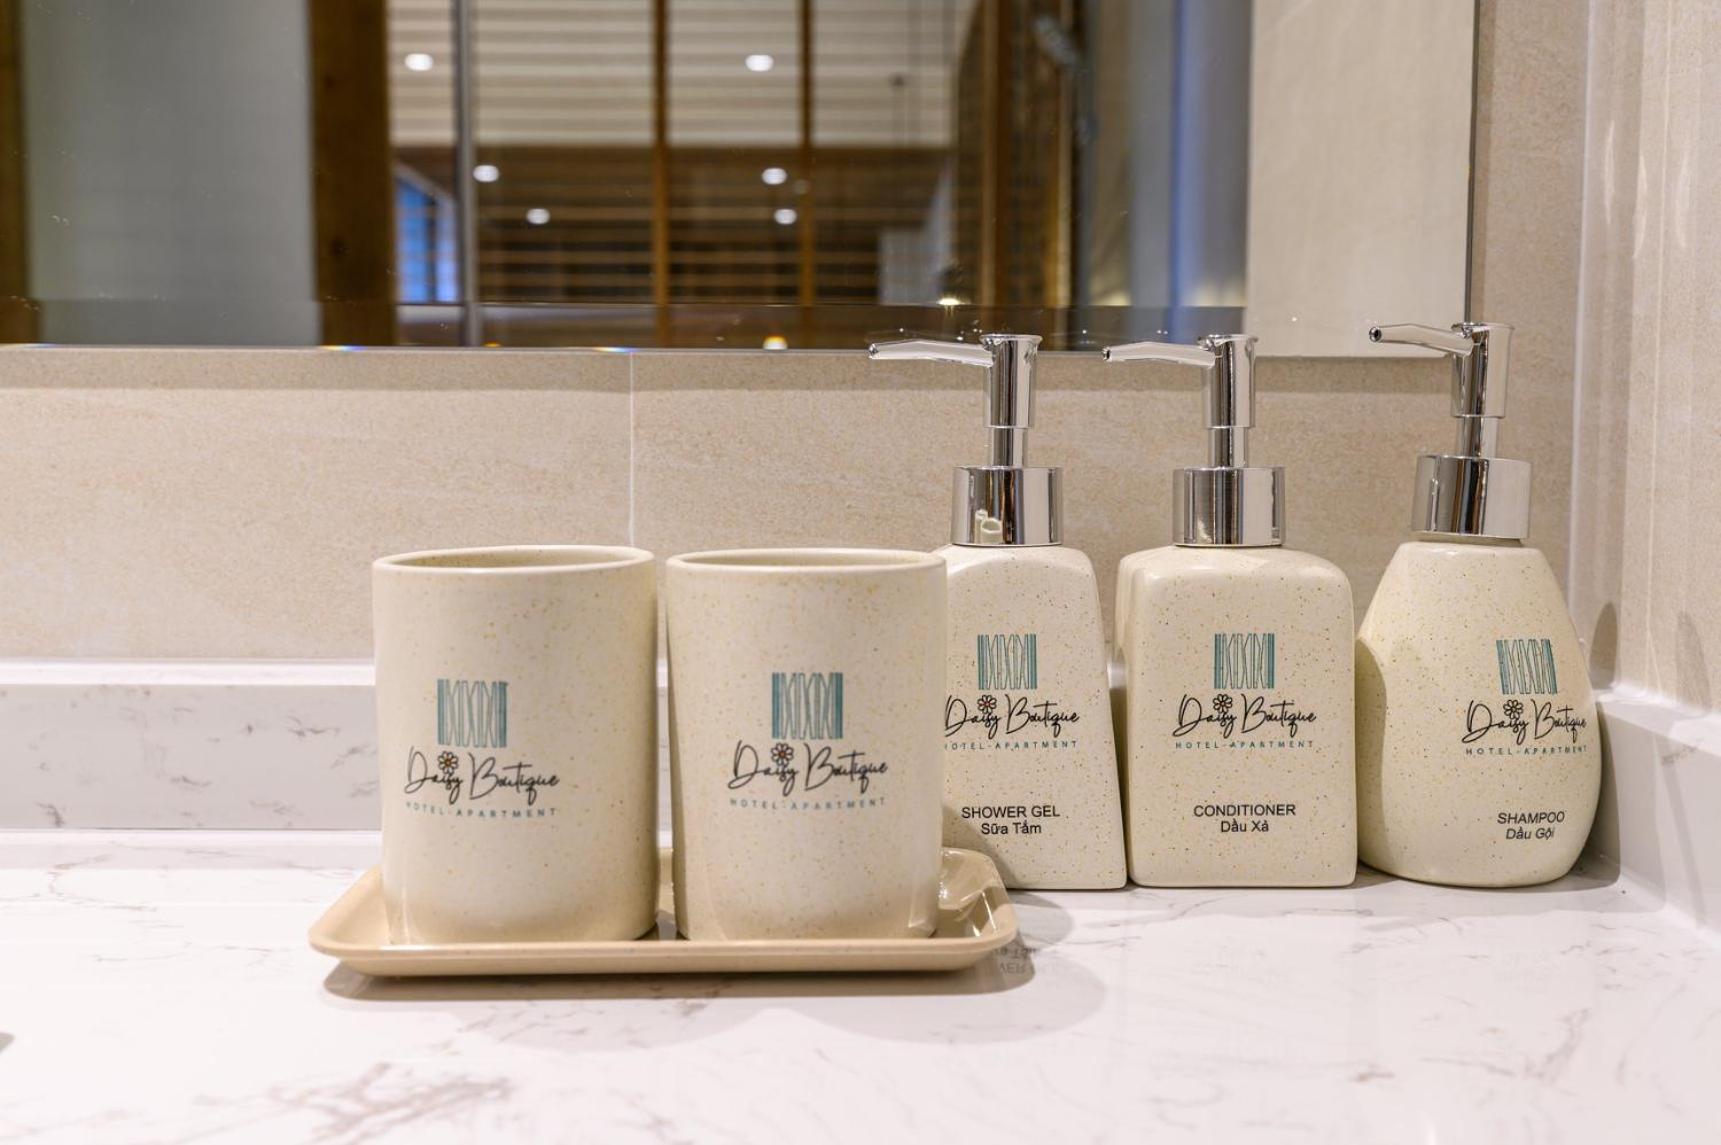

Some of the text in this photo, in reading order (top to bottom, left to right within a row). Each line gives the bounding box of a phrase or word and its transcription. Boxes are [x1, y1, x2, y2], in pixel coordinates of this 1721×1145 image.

[945, 693, 1080, 740] Daisy Boutique
[1172, 693, 1317, 739] Daisy Boutique
[1461, 699, 1588, 746] Daisy Boutique
[404, 746, 561, 806] Daisy Boutique
[728, 740, 889, 797] Daisy Boutique
[961, 804, 1061, 819] SHOWER GEL
[1193, 803, 1297, 818] CONDITIONER
[1496, 810, 1566, 825] SHAMPOO
[981, 822, 1009, 835] Sữa
[1220, 818, 1270, 834] Dầu Xả
[1505, 826, 1556, 841] Dầu Gội
